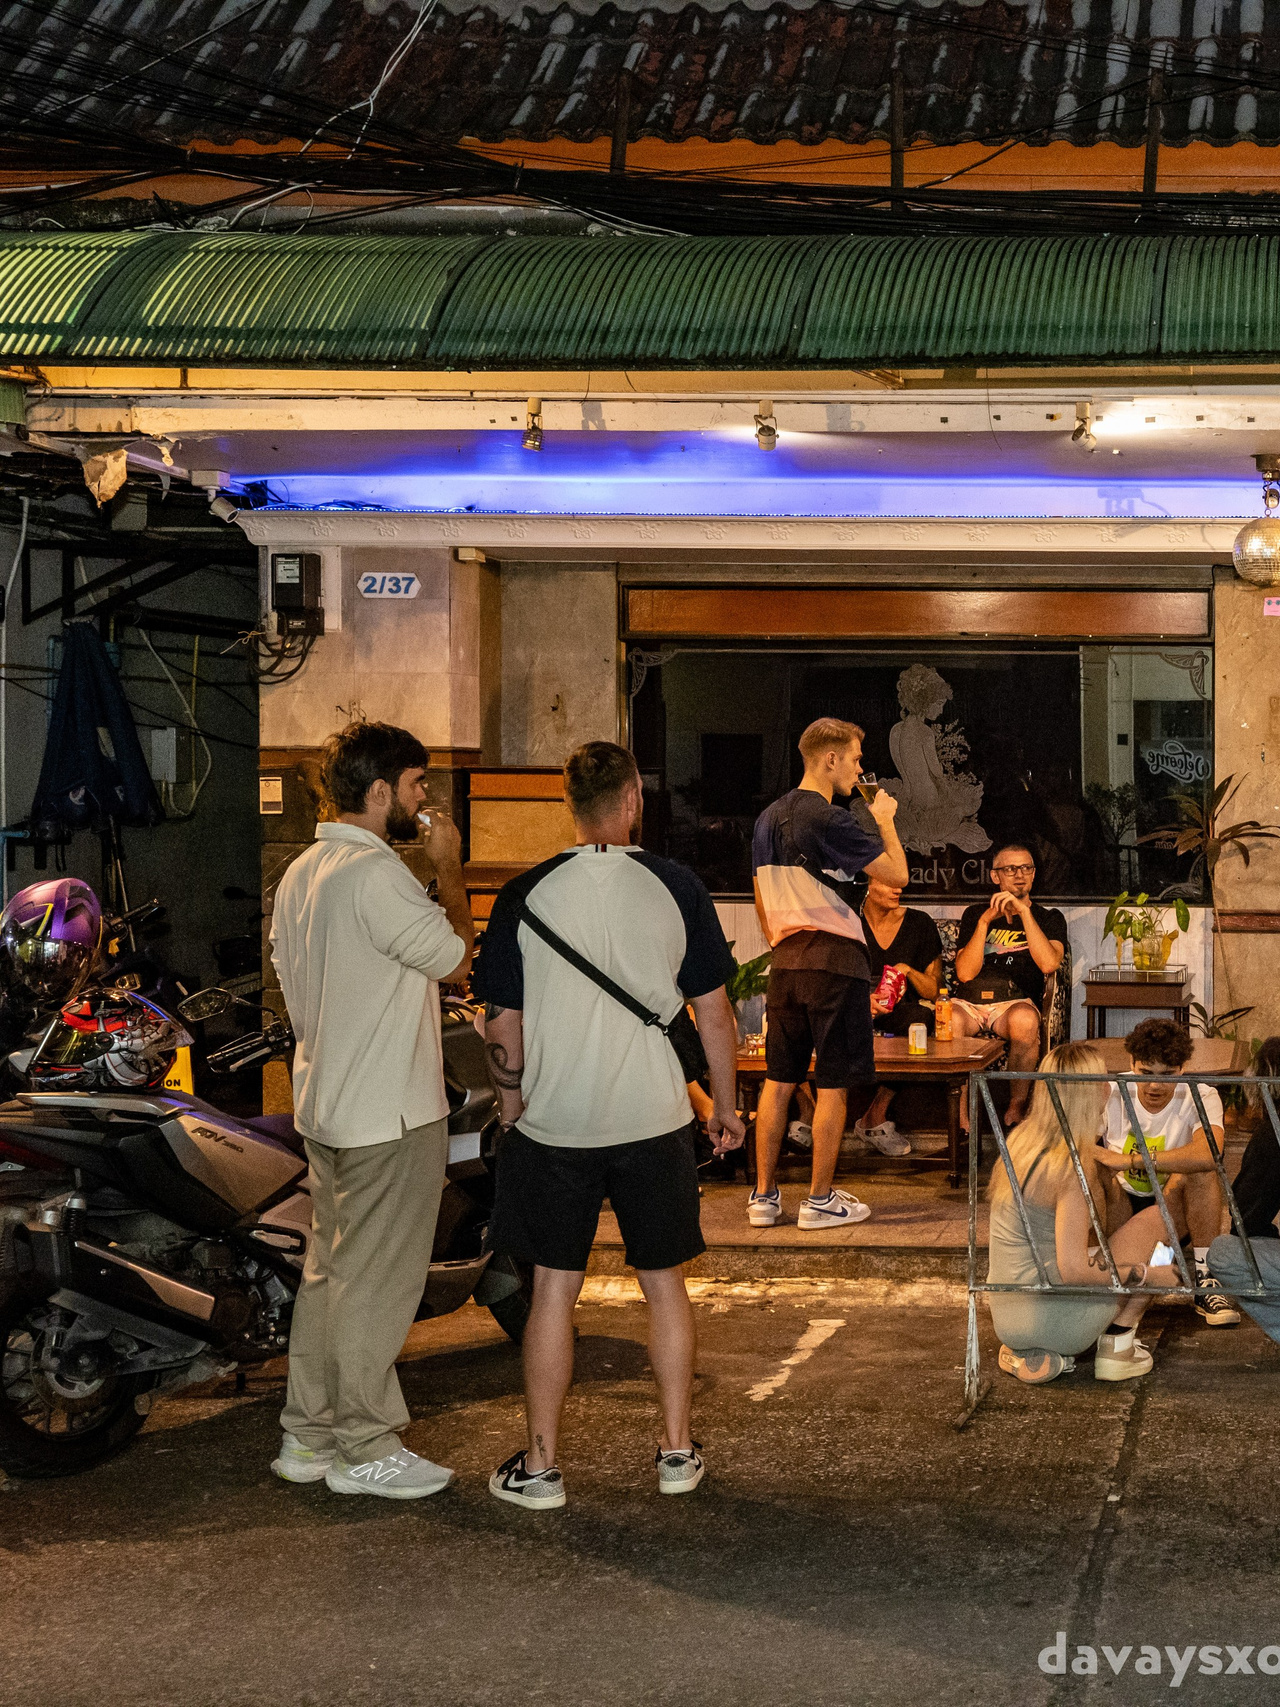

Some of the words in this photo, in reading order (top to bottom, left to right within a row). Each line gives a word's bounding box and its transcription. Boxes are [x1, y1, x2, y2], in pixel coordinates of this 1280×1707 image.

[363, 576, 416, 595] 2/37
[910, 859, 955, 890] ady
[986, 928, 1022, 947] NIKE
[162, 1079, 181, 1087] ION
